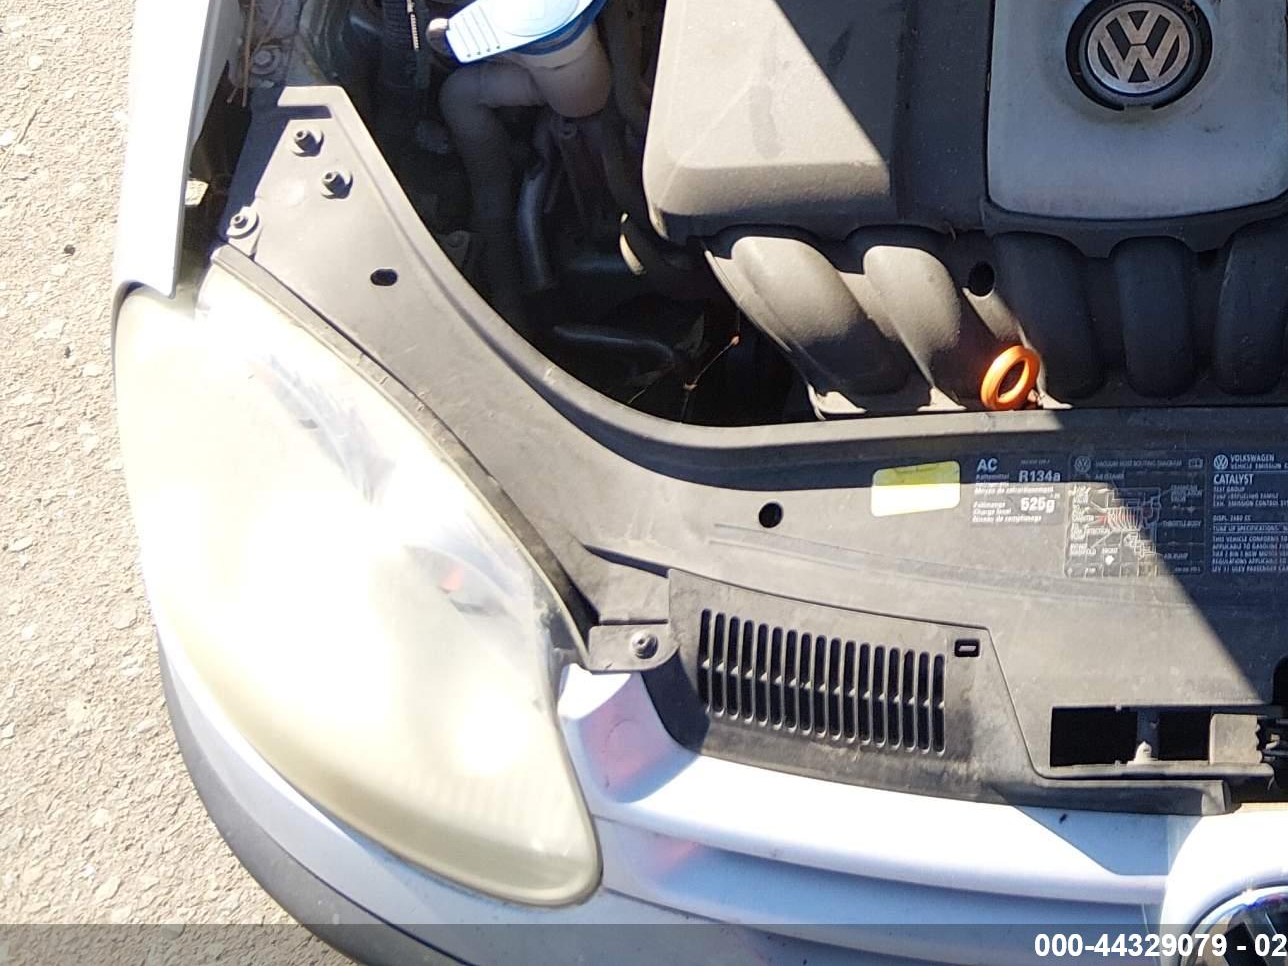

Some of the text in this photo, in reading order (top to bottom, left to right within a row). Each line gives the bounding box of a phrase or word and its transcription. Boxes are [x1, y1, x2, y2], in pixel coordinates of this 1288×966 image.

[1231, 453, 1275, 462] VOLKSWAGEN
[976, 457, 998, 473] AC
[1018, 469, 1061, 482] R134a
[1213, 473, 1255, 485] CATALYST
